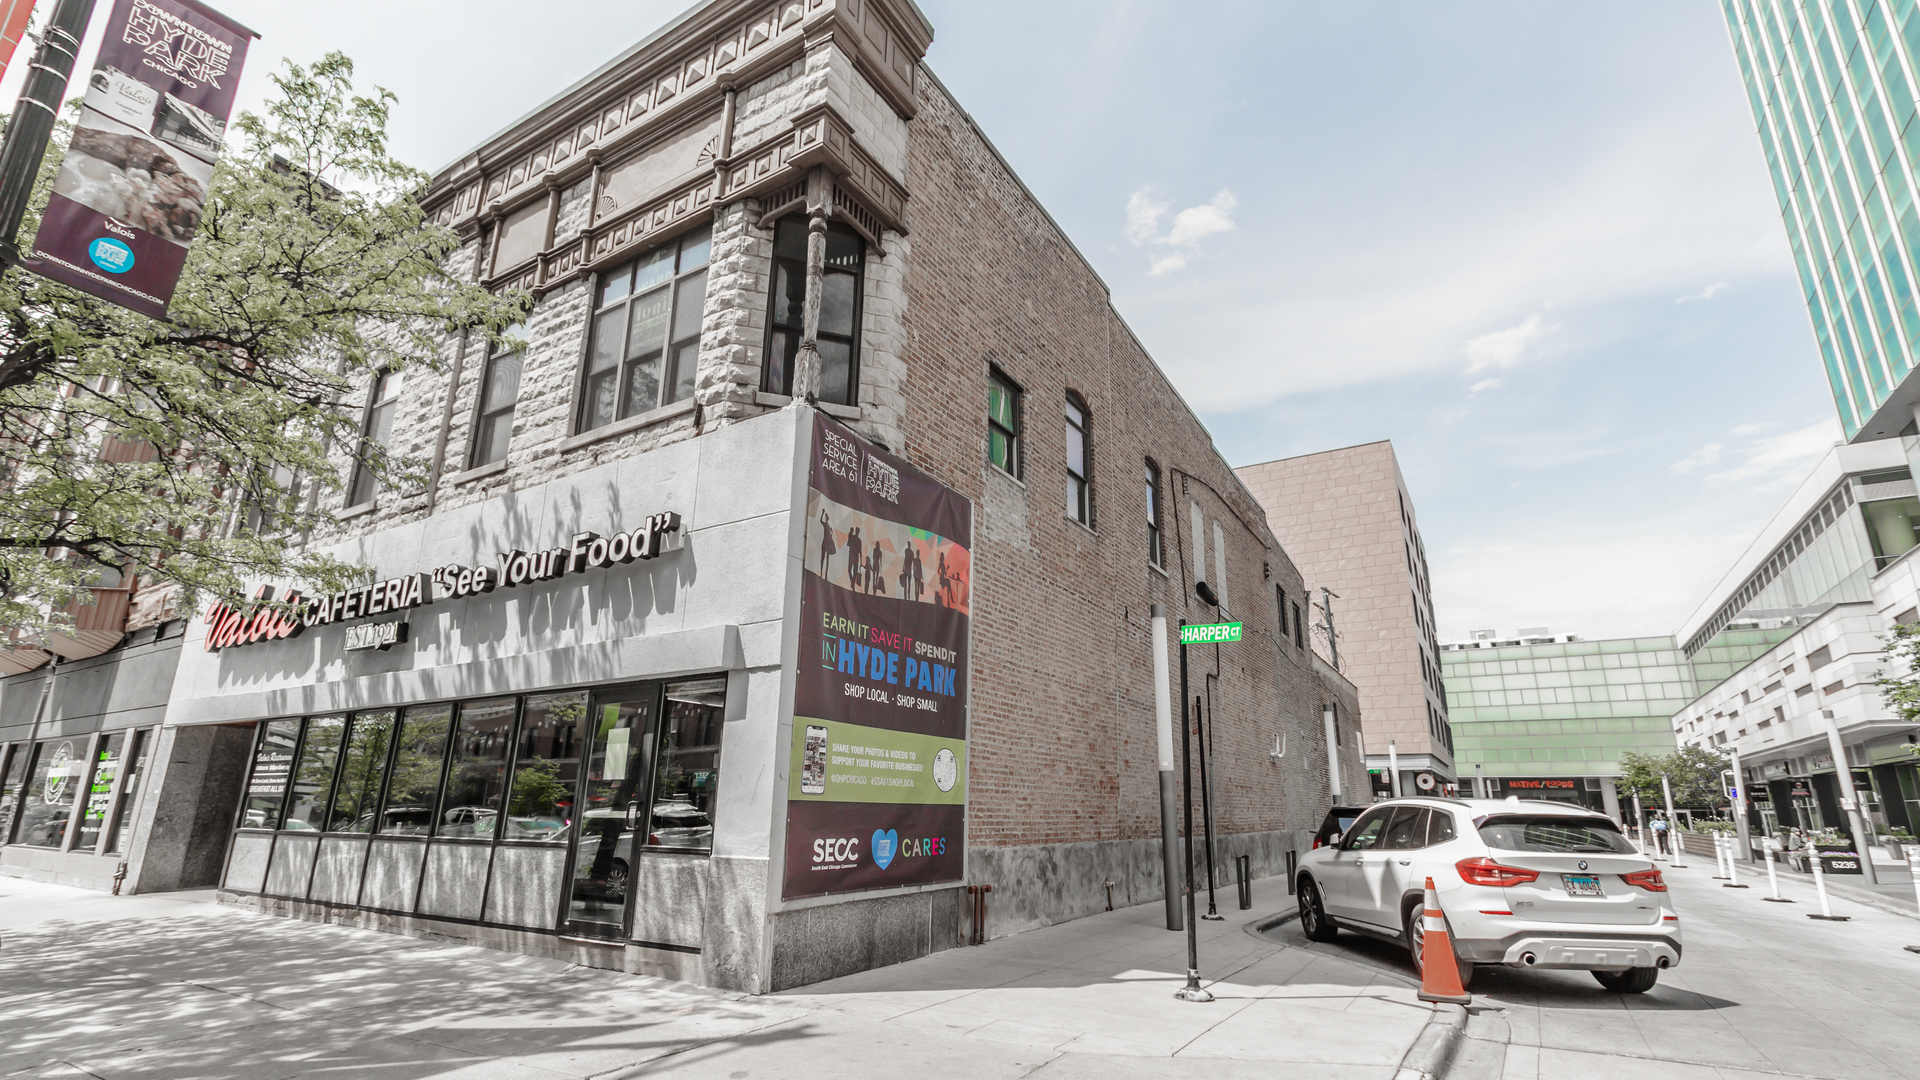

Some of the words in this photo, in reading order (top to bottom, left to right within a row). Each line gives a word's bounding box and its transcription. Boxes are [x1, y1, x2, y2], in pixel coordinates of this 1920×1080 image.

[128, 6, 231, 72] HYDE
[134, 0, 232, 54] DOWNTOWN
[123, 24, 221, 90] PARK
[142, 58, 197, 89] CHICAGO
[104, 221, 136, 240] Valois
[36, 250, 165, 305] DOWNTOWNHYDEPARKCHICAGO.COM
[823, 443, 858, 471] SERVICE
[825, 429, 858, 457] SPECIAL
[822, 457, 847, 478] AREA
[849, 472, 858, 483] 61
[867, 461, 899, 490] HYDE
[866, 475, 899, 505] PARK
[303, 573, 423, 627] CAFETERIA
[498, 547, 563, 586] Your
[823, 612, 855, 634] EARN
[858, 624, 869, 639] IT
[871, 628, 900, 649] SAVE
[903, 637, 914, 652] IT
[915, 641, 948, 660] SPEND
[948, 651, 957, 663] IT
[1184, 625, 1231, 642] HARPER
[1230, 626, 1241, 636] CT
[822, 640, 836, 662] IN
[838, 638, 899, 685] HYDE
[905, 657, 956, 697] PARK
[844, 683, 864, 697] SHOP
[867, 688, 889, 703] LOCAL
[897, 694, 915, 708] SHOP
[917, 698, 938, 712] SMALL
[832, 743, 850, 753] SHARE
[851, 745, 864, 755] YOUR
[865, 747, 884, 757] PHOTOS
[885, 749, 889, 758] &
[890, 750, 908, 759] VIDEOS
[909, 752, 916, 760] TO
[832, 756, 855, 766] SUPPORT
[856, 758, 869, 767] YOUR
[870, 760, 894, 770] FAVORITE
[1545, 780, 1575, 788] FOODS
[813, 837, 859, 863] SECC
[902, 837, 946, 857] CARES
[1832, 861, 1858, 869] 5235
